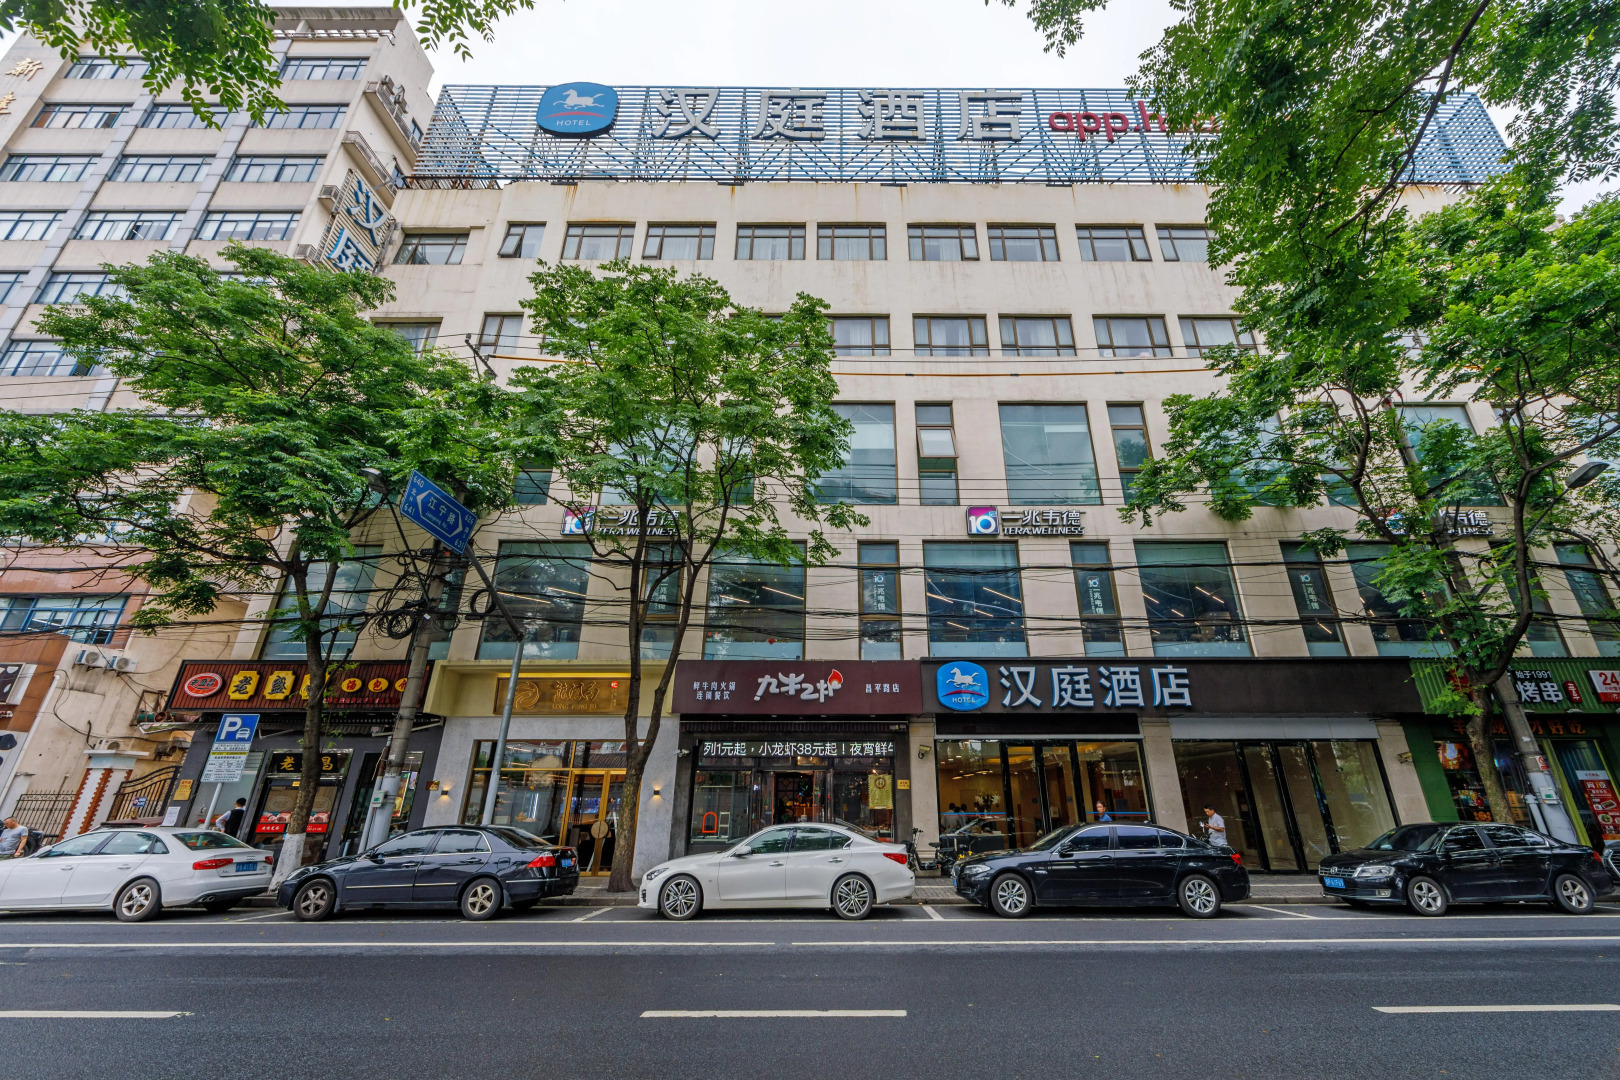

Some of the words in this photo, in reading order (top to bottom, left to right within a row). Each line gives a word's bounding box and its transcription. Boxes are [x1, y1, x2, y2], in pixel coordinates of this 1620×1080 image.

[556, 119, 592, 127] HOTEL
[651, 87, 1022, 141] 汉庭酒店
[427, 496, 457, 525] 江宁路
[1002, 509, 1081, 526] 一兆韦德
[1003, 527, 1030, 535] TERA
[1032, 527, 1085, 536] WELLNESS
[693, 681, 736, 691] 鲜牛肉火锅
[998, 665, 1193, 708] 汉庭酒店
[1515, 681, 1564, 703] 烤串
[219, 716, 242, 740] P
[280, 755, 334, 771] 老昌
